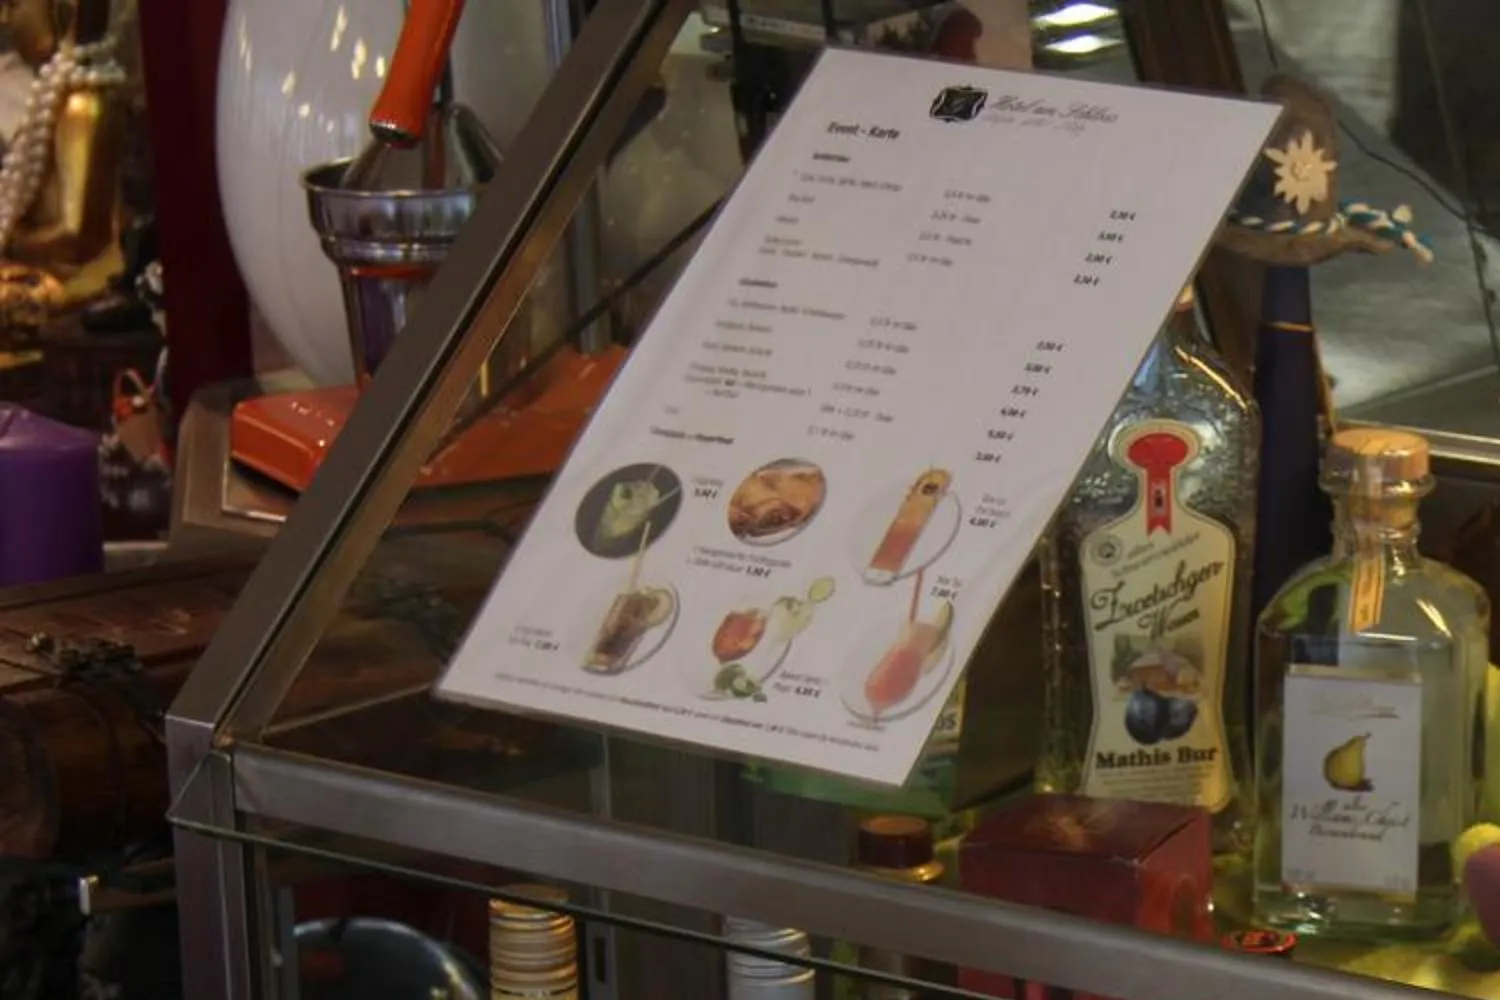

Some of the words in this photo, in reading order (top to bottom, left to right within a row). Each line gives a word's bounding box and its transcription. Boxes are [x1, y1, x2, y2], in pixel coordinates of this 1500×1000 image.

[827, 121, 859, 137] Event
[1096, 747, 1171, 769] Mathis
[1177, 746, 1218, 764] Bur
